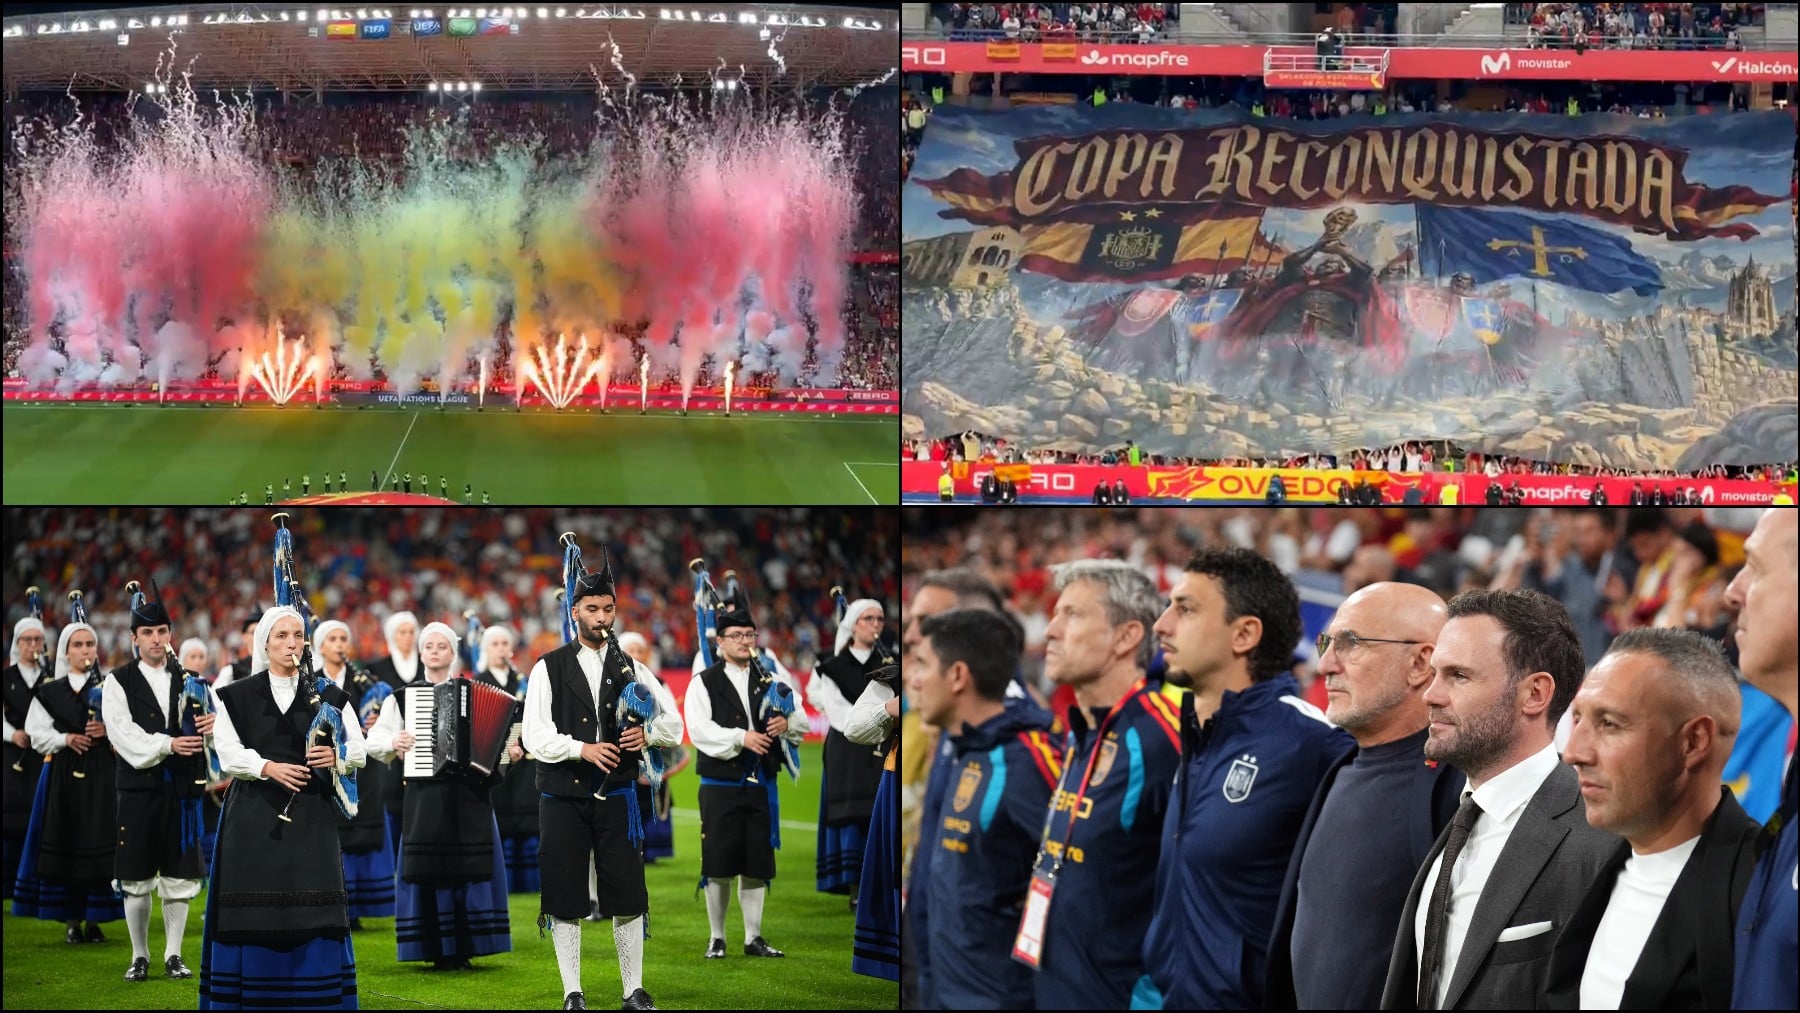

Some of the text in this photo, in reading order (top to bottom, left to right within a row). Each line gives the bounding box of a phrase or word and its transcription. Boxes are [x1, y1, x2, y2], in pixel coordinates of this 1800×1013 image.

[364, 25, 385, 33] FIFA
[414, 20, 441, 31] UEFA
[1112, 50, 1189, 69] mapfre
[1517, 57, 1572, 69] movistar
[1738, 60, 1792, 75] Halcón
[1014, 125, 1675, 234] COPA RECONQUISTADA
[378, 394, 397, 403] UEFA
[973, 472, 1075, 490] ERO
[1218, 475, 1349, 497] OVEDO
[1520, 485, 1592, 502] mapfre
